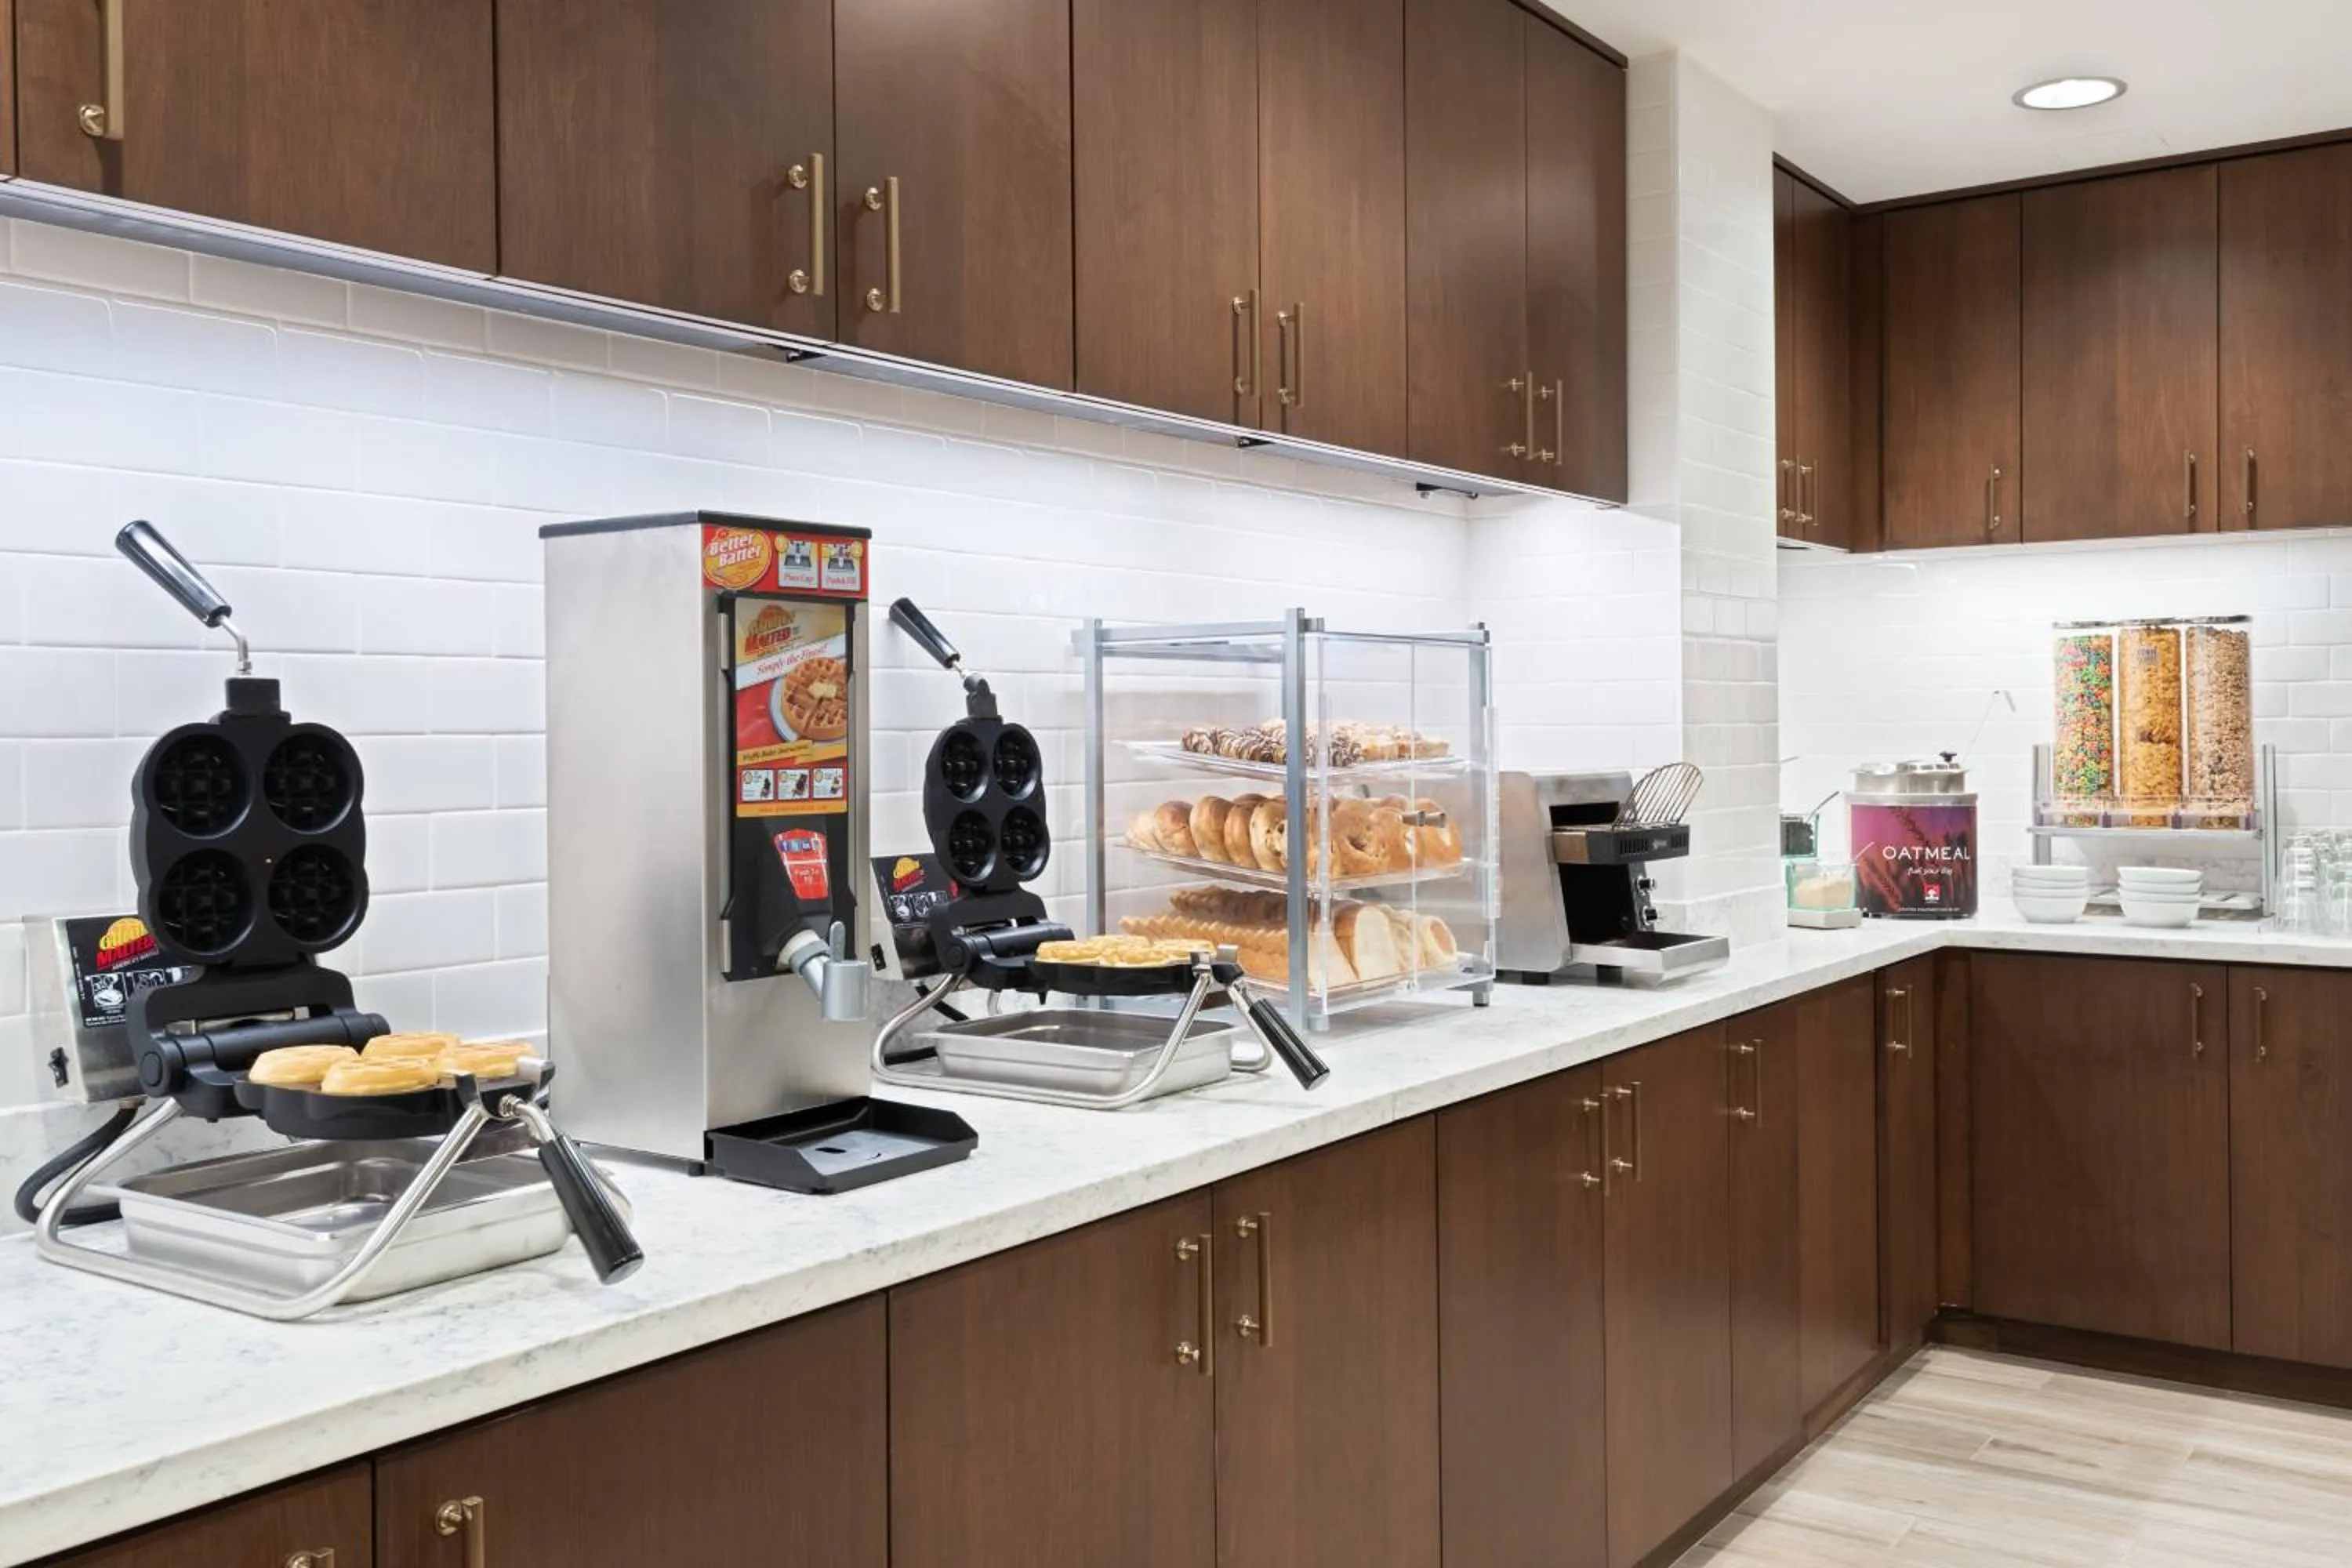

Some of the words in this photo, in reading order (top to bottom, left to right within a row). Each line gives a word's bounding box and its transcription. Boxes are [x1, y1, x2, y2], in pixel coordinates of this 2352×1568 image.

[709, 534, 753, 556] Better
[719, 546, 760, 565] Batter
[1882, 846, 1971, 860] OATMEAL
